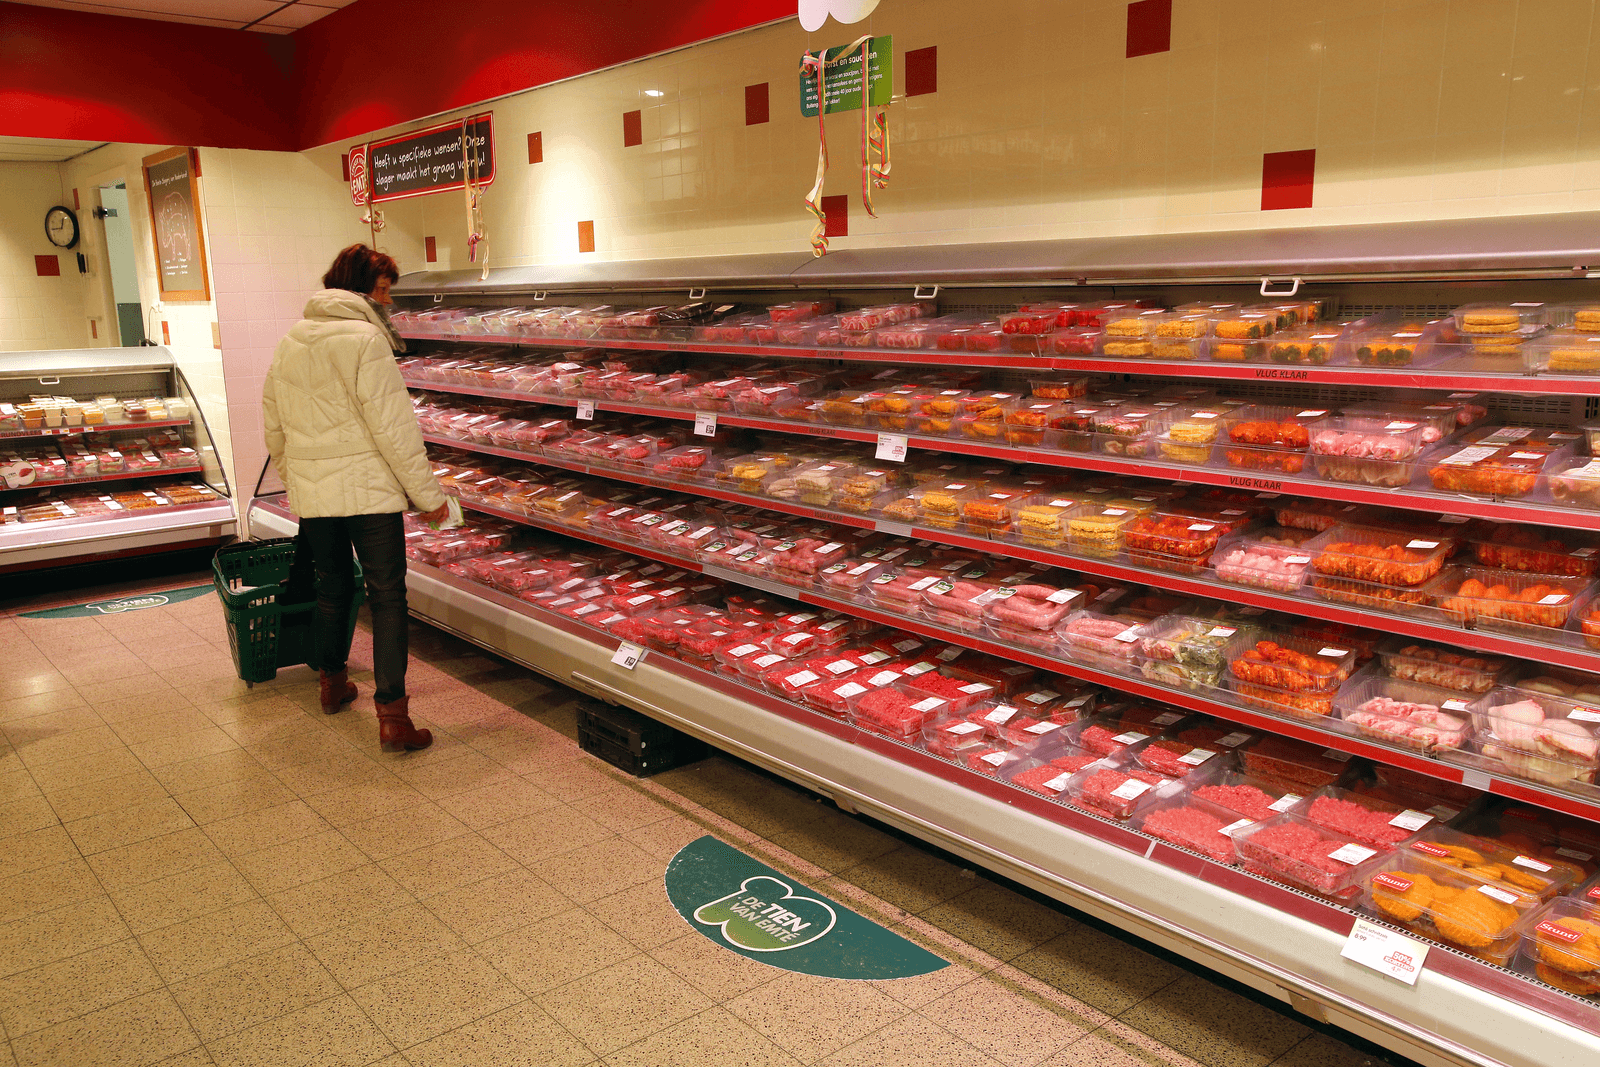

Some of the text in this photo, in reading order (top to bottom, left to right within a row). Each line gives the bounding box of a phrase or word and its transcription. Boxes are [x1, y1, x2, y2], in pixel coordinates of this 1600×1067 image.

[373, 152, 391, 169] Heeft
[392, 157, 398, 166] u
[398, 147, 432, 168] specifieke
[433, 136, 462, 156] wensen?
[465, 135, 485, 149] Onze
[375, 174, 395, 191] slager
[396, 166, 418, 182] maakt
[419, 163, 431, 178] het
[432, 162, 456, 182] graag
[477, 151, 486, 167] u!
[1255, 369, 1308, 380] VLUG KLAAR
[1229, 476, 1282, 491] VLUG KLAAR
[1413, 841, 1448, 856] Stunt!
[1375, 872, 1412, 891] Stunt!
[729, 902, 801, 943] VAN EMTÉ
[742, 896, 812, 933] DE TIEN
[1539, 922, 1579, 940] Stunt!
[1393, 952, 1411, 965] 50%
